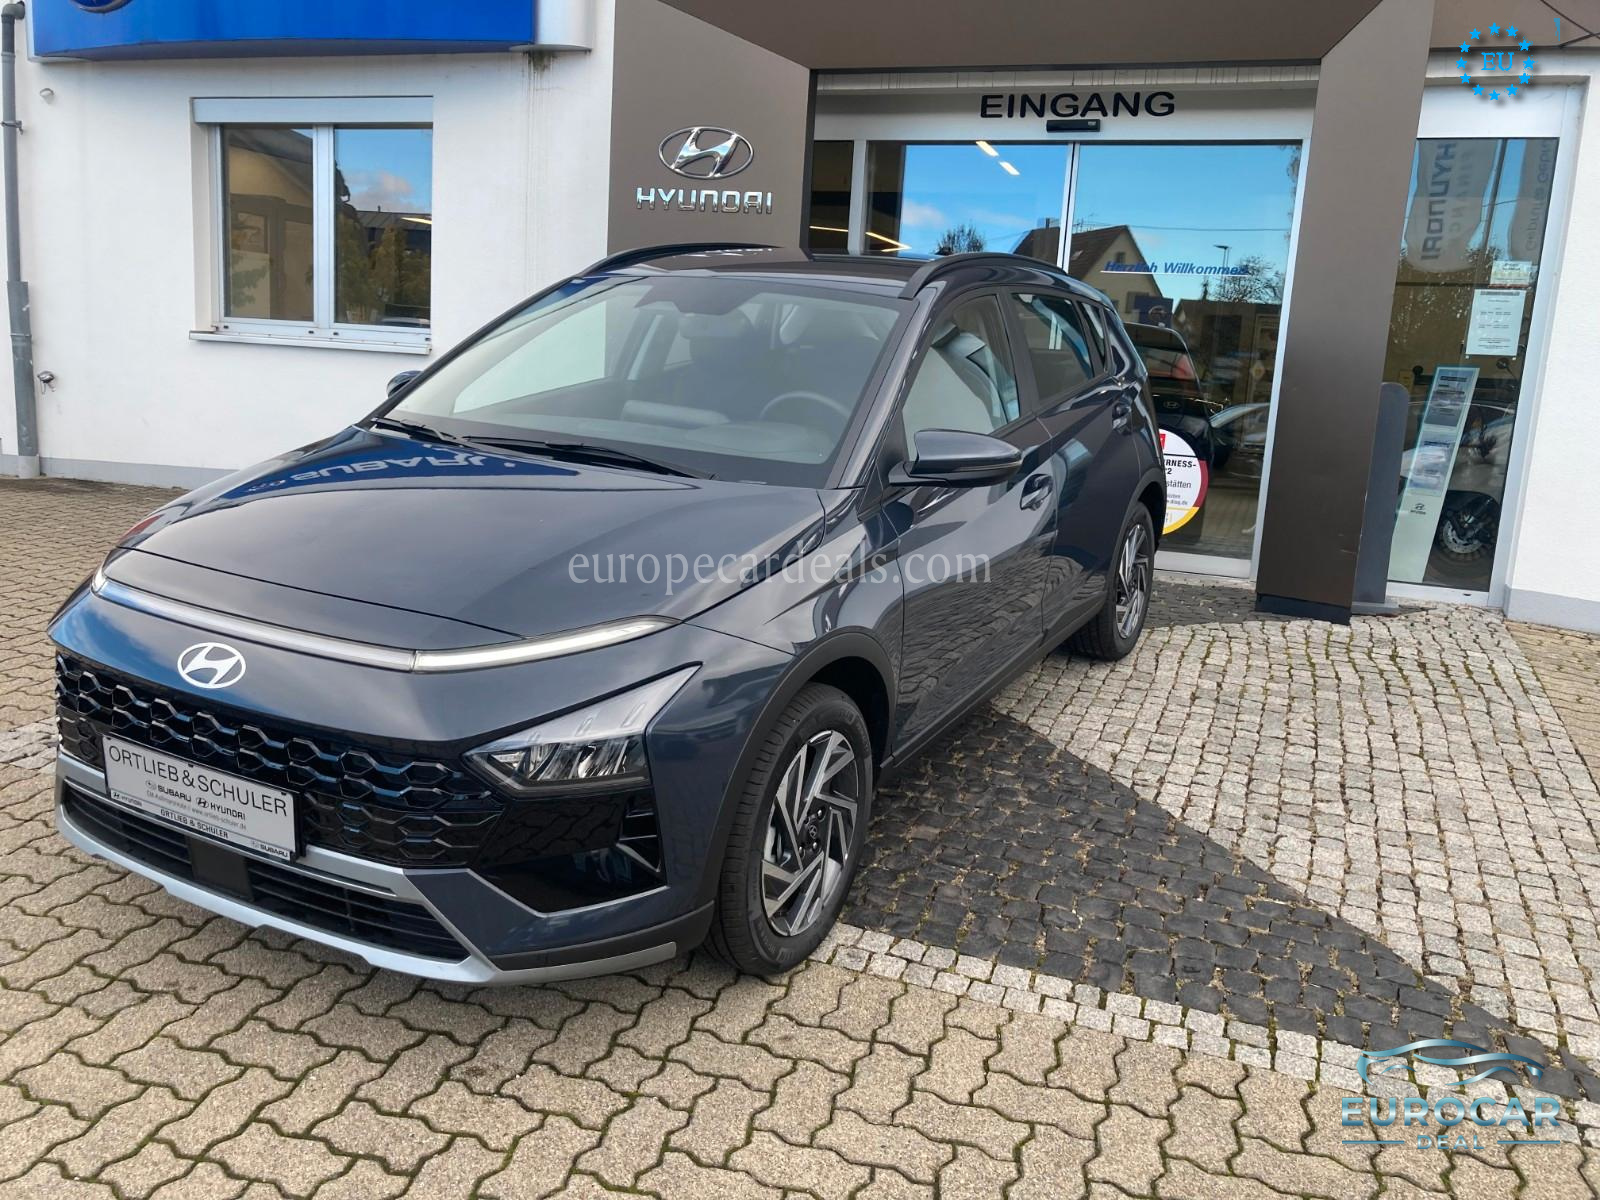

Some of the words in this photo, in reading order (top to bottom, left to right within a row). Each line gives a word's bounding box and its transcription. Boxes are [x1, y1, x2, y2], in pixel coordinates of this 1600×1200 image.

[980, 91, 1175, 118] EINGANG
[636, 187, 773, 215] HYUNDAI
[1164, 459, 1197, 469] RNESS-
[109, 745, 179, 782] ORTLIEB
[197, 775, 287, 817] SCHULER
[157, 784, 192, 802] SUBARU
[210, 802, 246, 820] HYUNDAI
[160, 808, 188, 824] ORTLIEB
[197, 822, 229, 839] SCHULER
[260, 844, 288, 857] SUBARU
